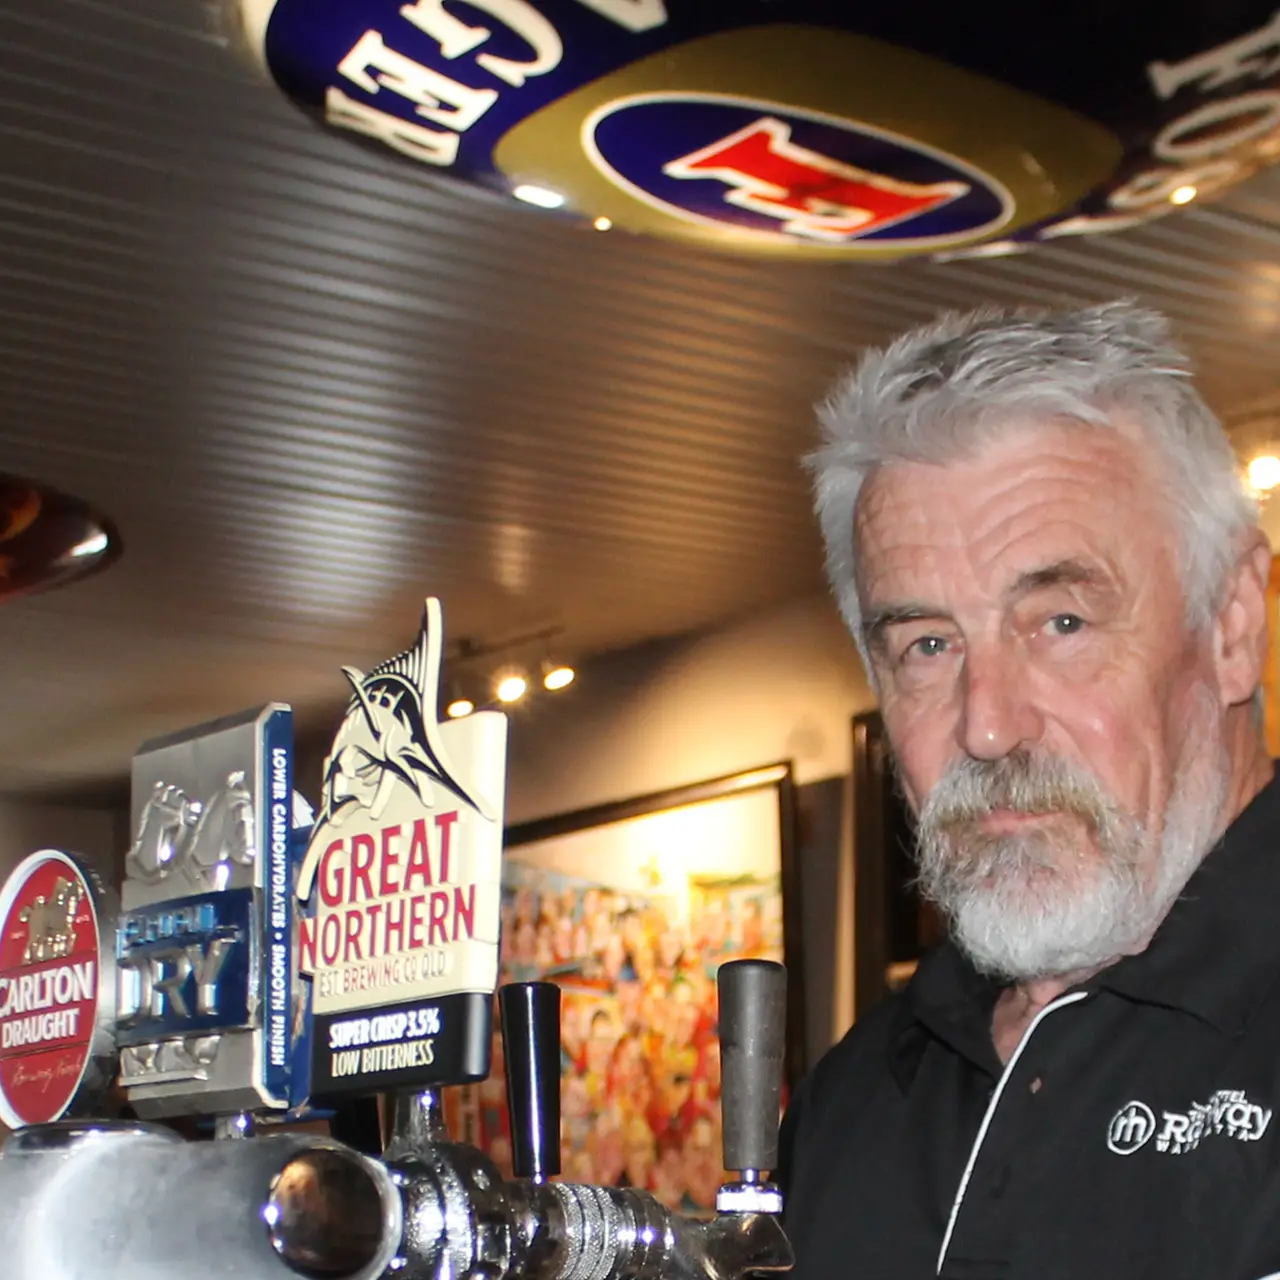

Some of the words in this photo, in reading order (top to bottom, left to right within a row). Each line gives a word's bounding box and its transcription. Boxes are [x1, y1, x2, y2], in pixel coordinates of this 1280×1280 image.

[271, 747, 287, 798] LOWER
[271, 803, 287, 930] CARBOHYDRATES
[320, 810, 458, 908] GREAT
[298, 884, 477, 972] NORTHERN
[270, 944, 287, 1011] SMOOTH
[1, 1006, 81, 1049] DRAUGHT
[270, 1016, 286, 1066] FINISH
[329, 1018, 370, 1049] SUPER
[370, 1012, 407, 1043] CRISP
[405, 1006, 441, 1038] 3.5%
[331, 1049, 361, 1078] LOW
[361, 1038, 435, 1074] BITTERNESS
